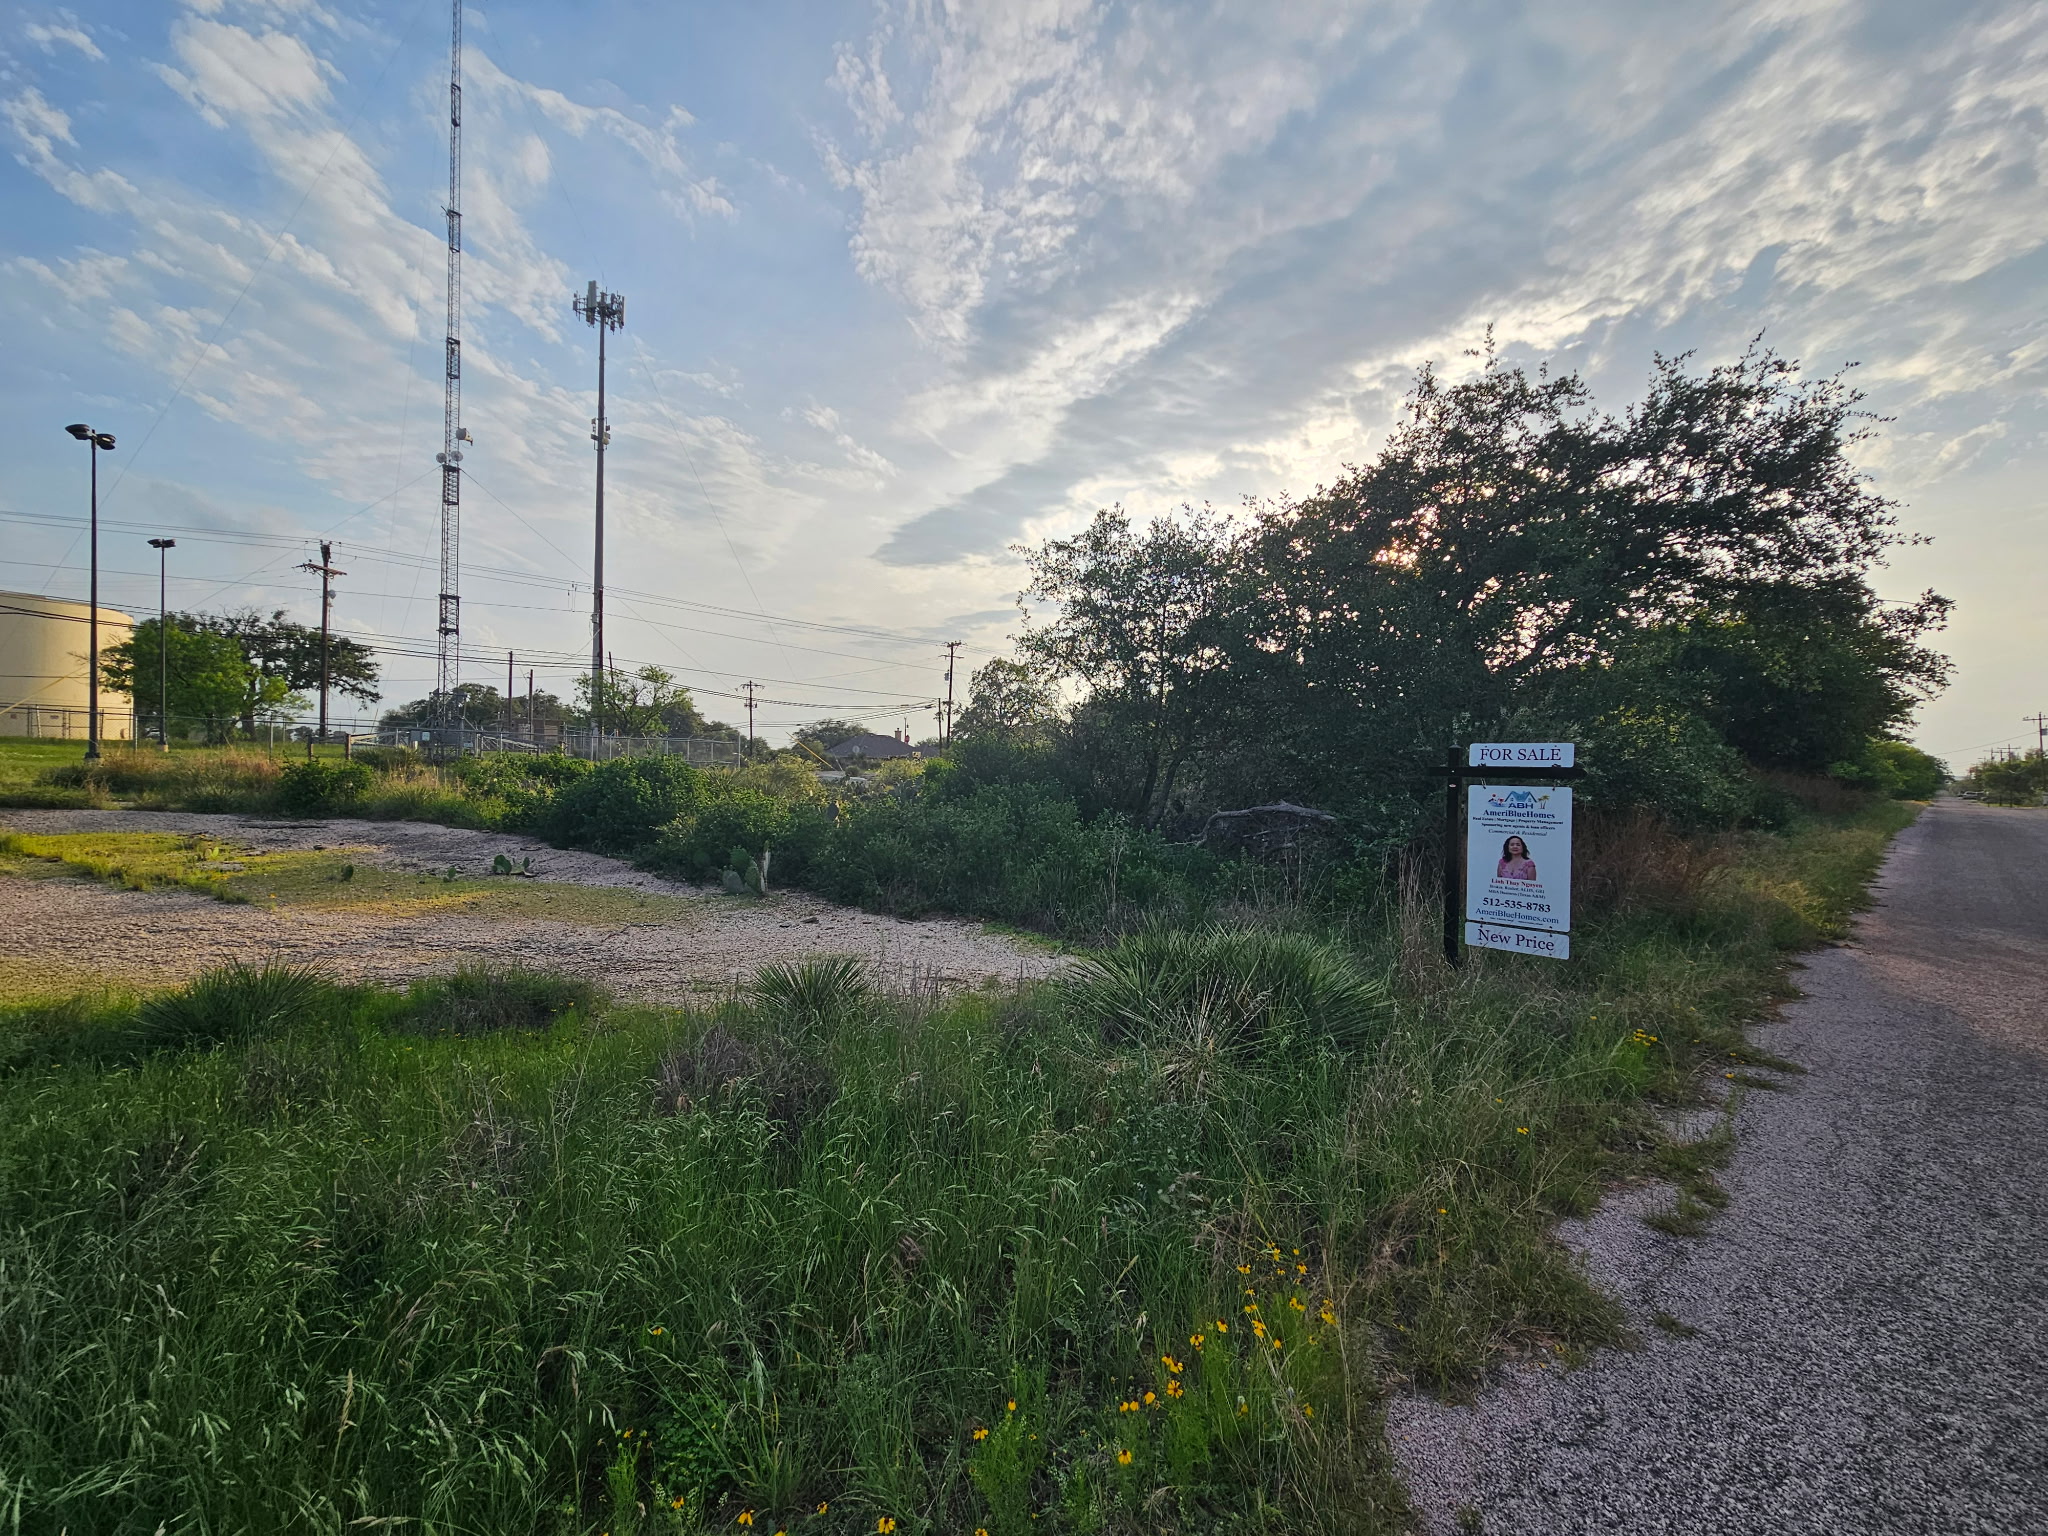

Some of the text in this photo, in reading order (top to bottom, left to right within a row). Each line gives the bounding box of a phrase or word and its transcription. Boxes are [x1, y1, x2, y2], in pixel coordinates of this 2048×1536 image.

[1480, 748, 1561, 760] FOR SALE
[1483, 810, 1555, 818] AmeriBlueHomes
[1483, 897, 1550, 912] 512-535-8783
[1476, 908, 1559, 924] AmeriBlueHomes.com
[1478, 928, 1554, 950] New Price
